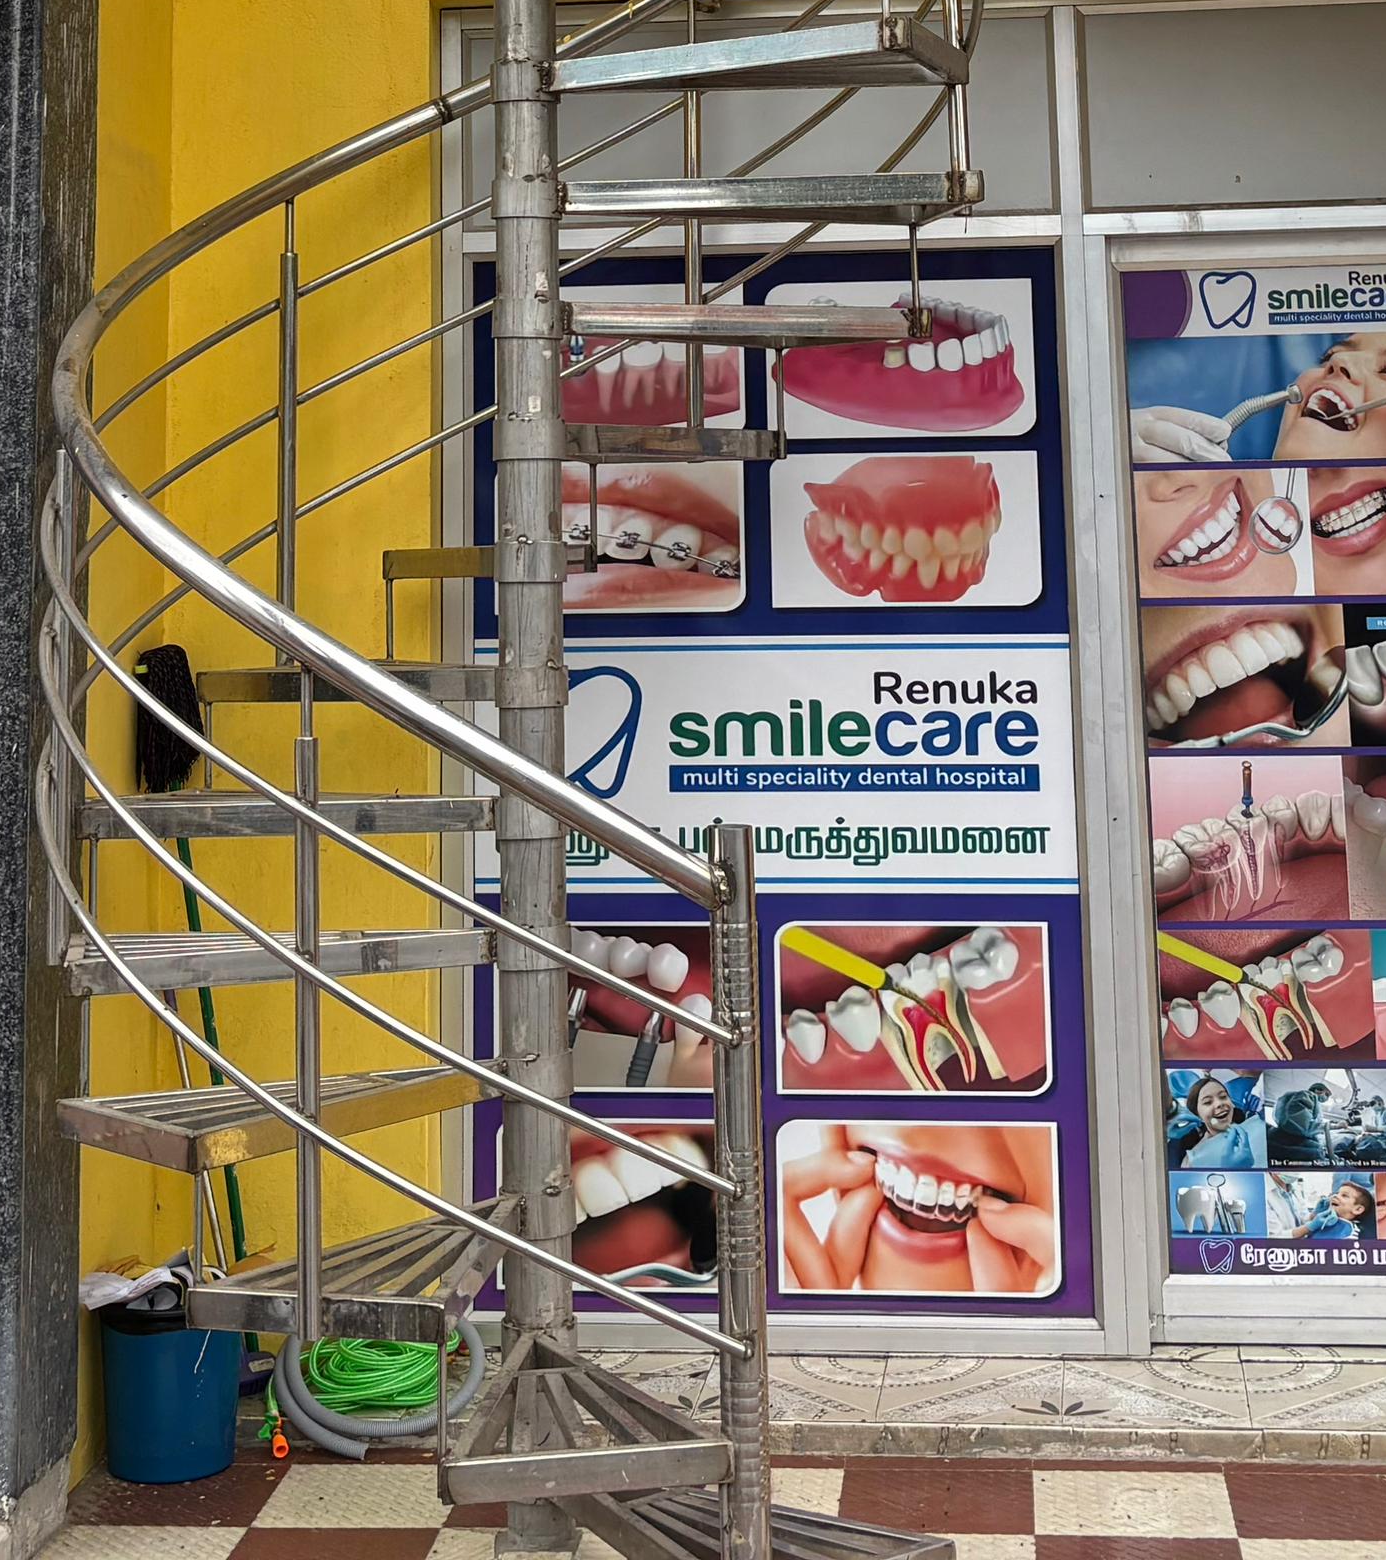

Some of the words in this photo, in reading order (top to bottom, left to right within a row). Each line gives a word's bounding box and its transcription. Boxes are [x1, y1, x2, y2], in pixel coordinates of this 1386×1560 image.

[1274, 313, 1298, 322] multi
[1300, 312, 1342, 323] speciality
[1344, 311, 1372, 321] dental
[873, 671, 1039, 705] Renuka
[669, 699, 1040, 758] smilecare
[683, 767, 739, 786] multi
[746, 767, 852, 790] speciality
[858, 767, 929, 786] dental
[935, 767, 1027, 790] hospital
[1333, 1242, 1368, 1266] பல்
